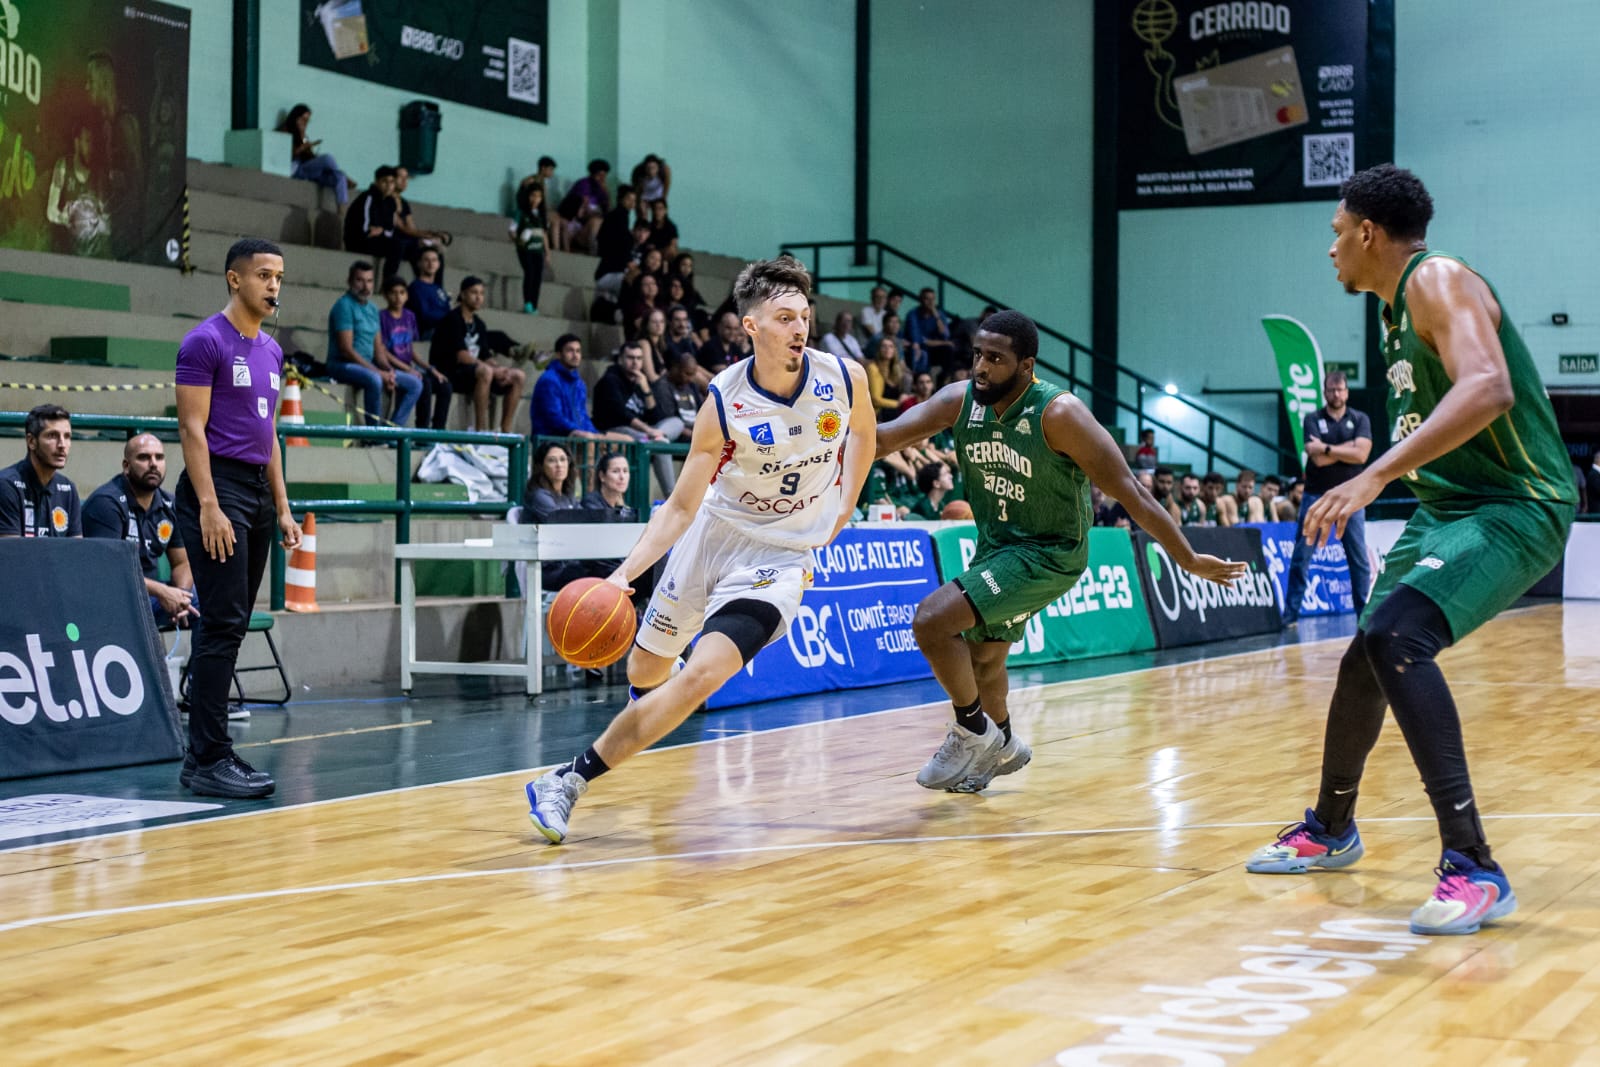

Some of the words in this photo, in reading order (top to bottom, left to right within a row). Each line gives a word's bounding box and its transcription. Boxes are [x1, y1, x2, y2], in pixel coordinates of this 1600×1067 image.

[1190, 1, 1290, 40] CERRADO
[1287, 363, 1317, 428] ite
[965, 441, 1032, 478] CERRADO
[780, 473, 800, 496] 9
[995, 477, 1025, 502] BRB
[845, 543, 868, 572] DE
[867, 540, 924, 569] ATLETAS
[986, 574, 1001, 595] BRB
[848, 600, 888, 632] COMITÊ
[876, 637, 885, 650] DE
